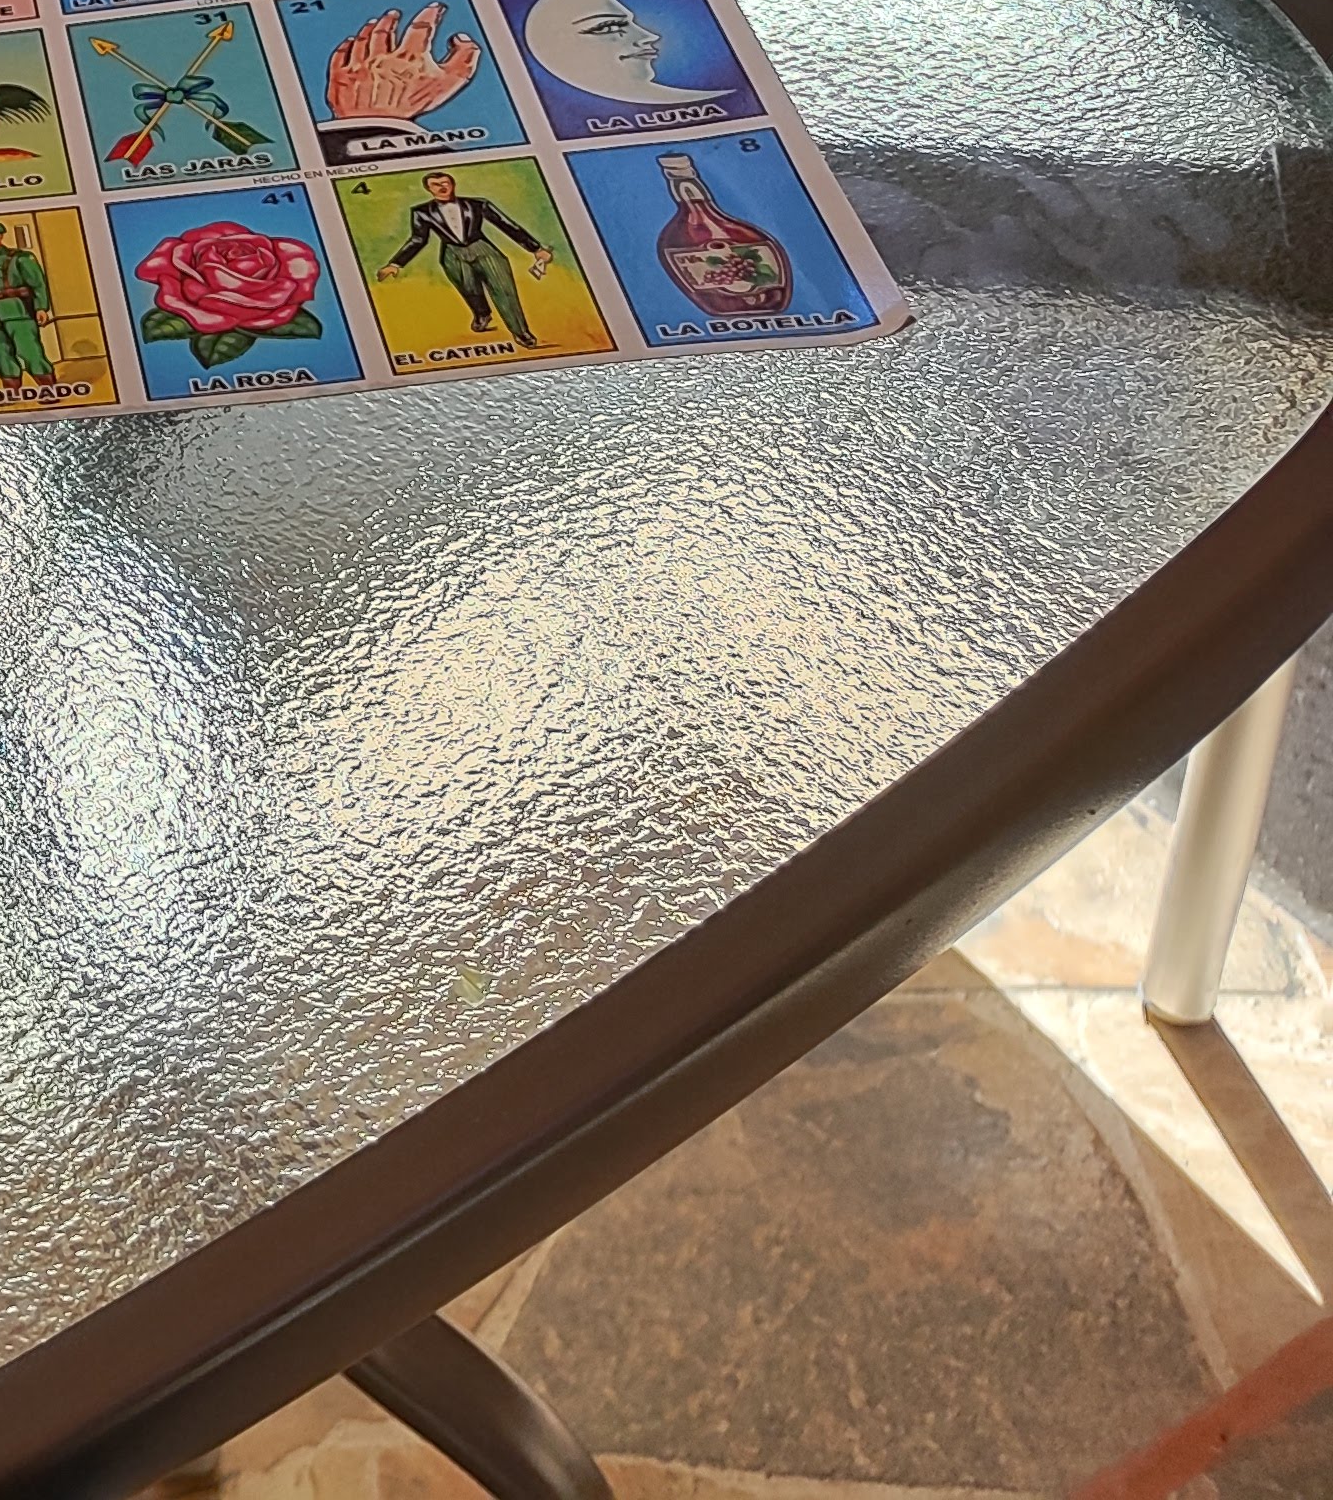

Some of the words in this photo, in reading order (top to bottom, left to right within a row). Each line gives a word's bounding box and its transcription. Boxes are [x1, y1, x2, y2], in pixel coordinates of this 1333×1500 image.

[290, 0, 326, 14] 21
[193, 11, 228, 25] 31
[589, 116, 631, 131] LA
[637, 104, 725, 125] LUNA
[361, 138, 397, 152] LA
[405, 128, 486, 146] MANO
[739, 137, 762, 153] 8
[123, 164, 175, 180] LAS
[184, 154, 272, 173] JARAS
[252, 173, 301, 185] HECHO
[304, 169, 324, 179] EN
[261, 190, 296, 205] 41
[351, 181, 372, 195] 4
[659, 323, 702, 338] LA
[710, 310, 857, 334] BOTELLA
[395, 353, 423, 367] EL
[428, 342, 516, 362] CATRIN
[191, 377, 229, 393] LA
[236, 368, 315, 388] ROSA
